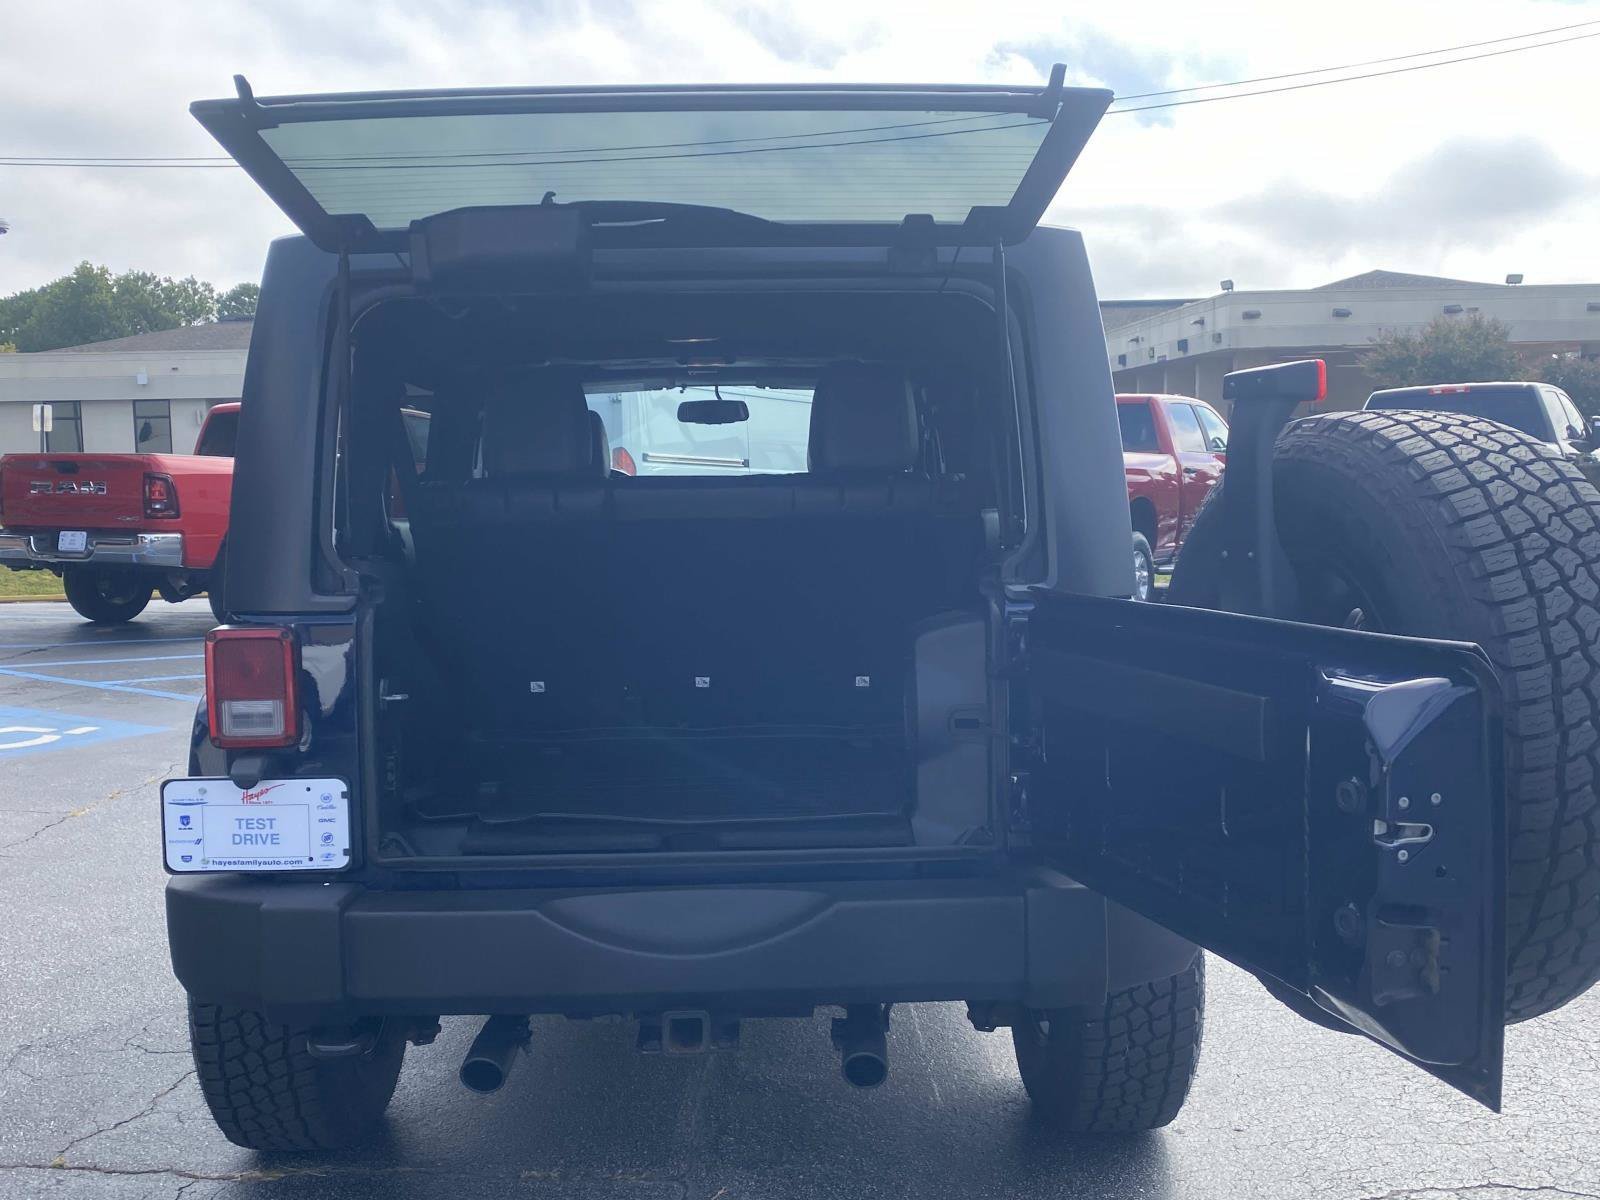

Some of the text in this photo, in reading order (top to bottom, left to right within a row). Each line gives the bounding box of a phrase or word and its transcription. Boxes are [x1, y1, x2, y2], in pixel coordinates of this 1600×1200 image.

[30, 481, 107, 494] RAM
[235, 818, 276, 830] TEST
[232, 833, 280, 846] DRIVE
[212, 859, 303, 867] hayesfamilyauto.com
